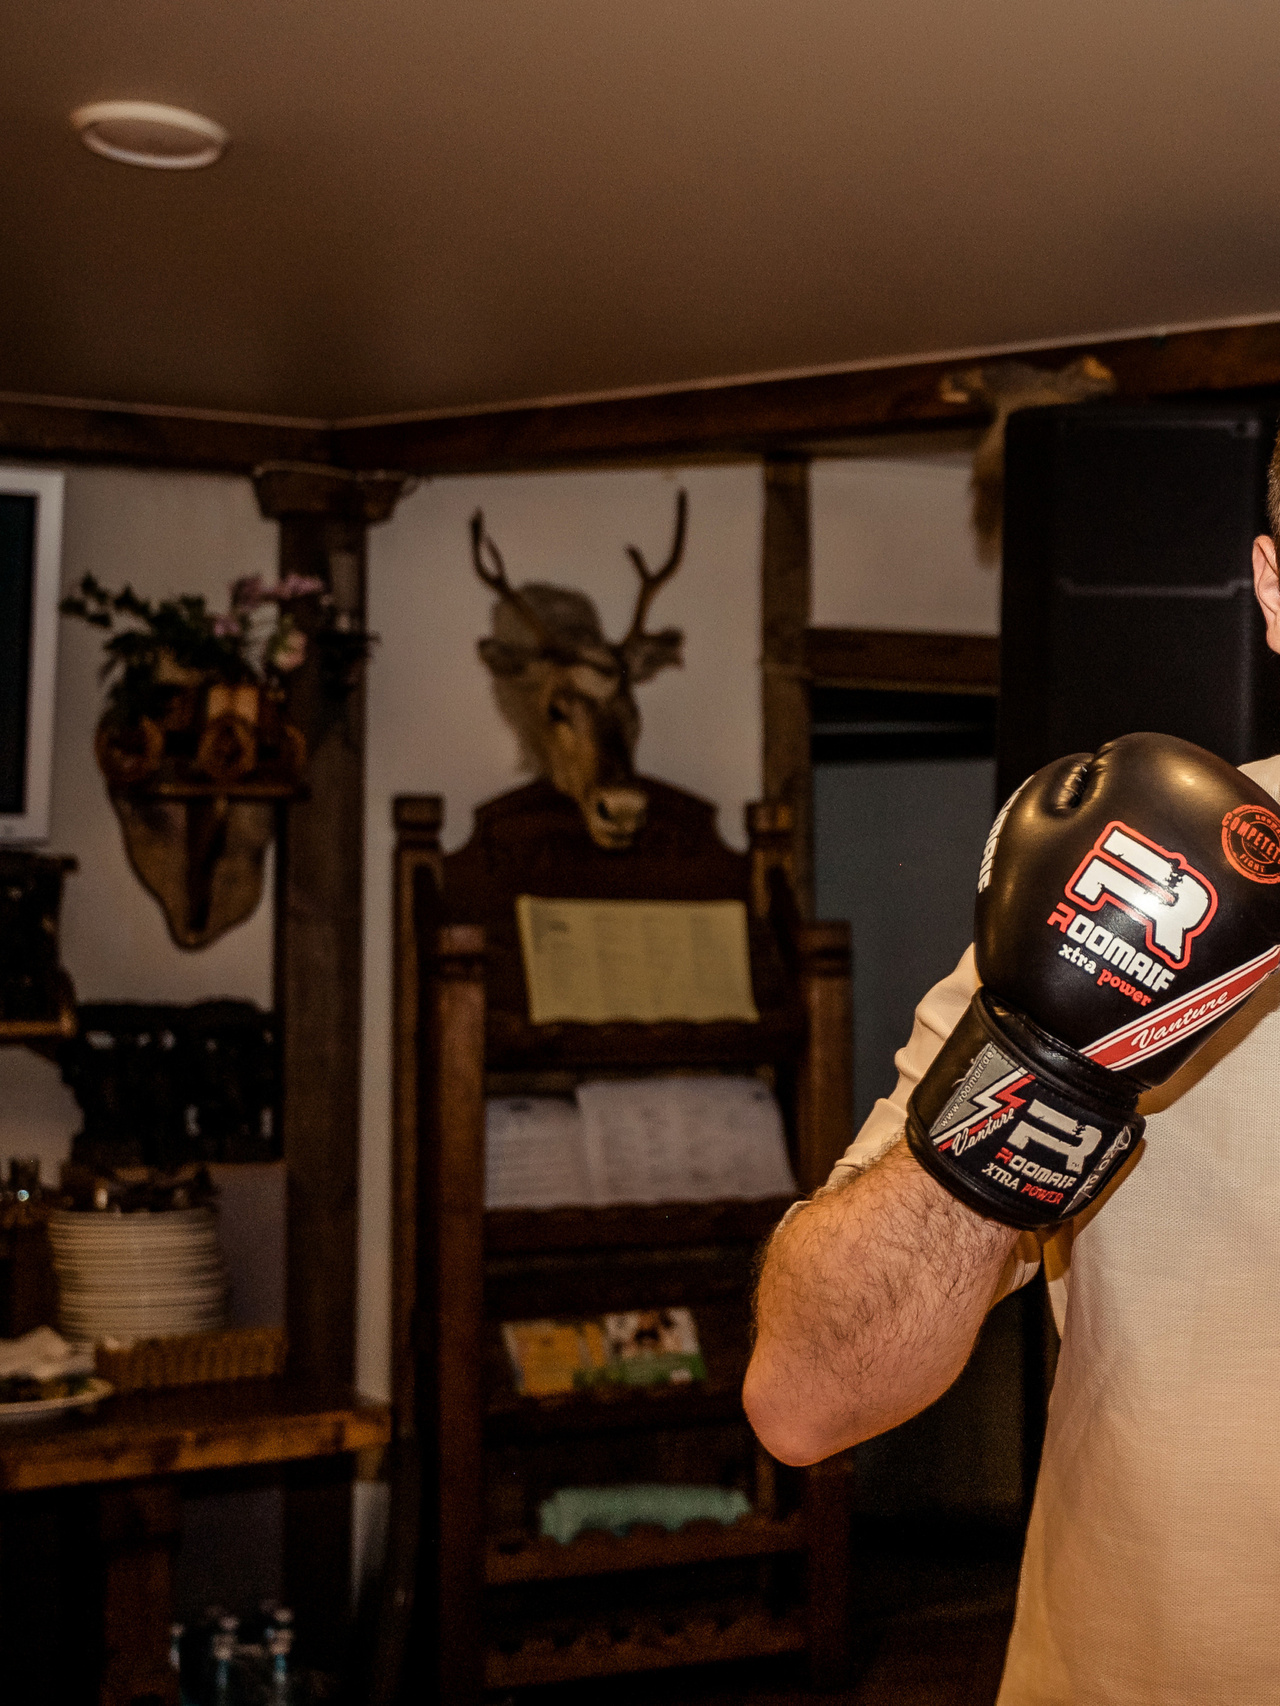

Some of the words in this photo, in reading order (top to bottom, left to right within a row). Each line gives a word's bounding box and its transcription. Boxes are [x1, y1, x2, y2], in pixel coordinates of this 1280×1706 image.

[1047, 903, 1175, 992] ROOMAIF
[1058, 944, 1098, 975] xtra
[1097, 967, 1152, 1007] power
[1131, 991, 1228, 1049] Vanture
[951, 1107, 1014, 1156] Vanture
[981, 1162, 1020, 1191] XTRA
[1020, 1182, 1064, 1204] POWER
[995, 1146, 1077, 1189] ROOMAIF
